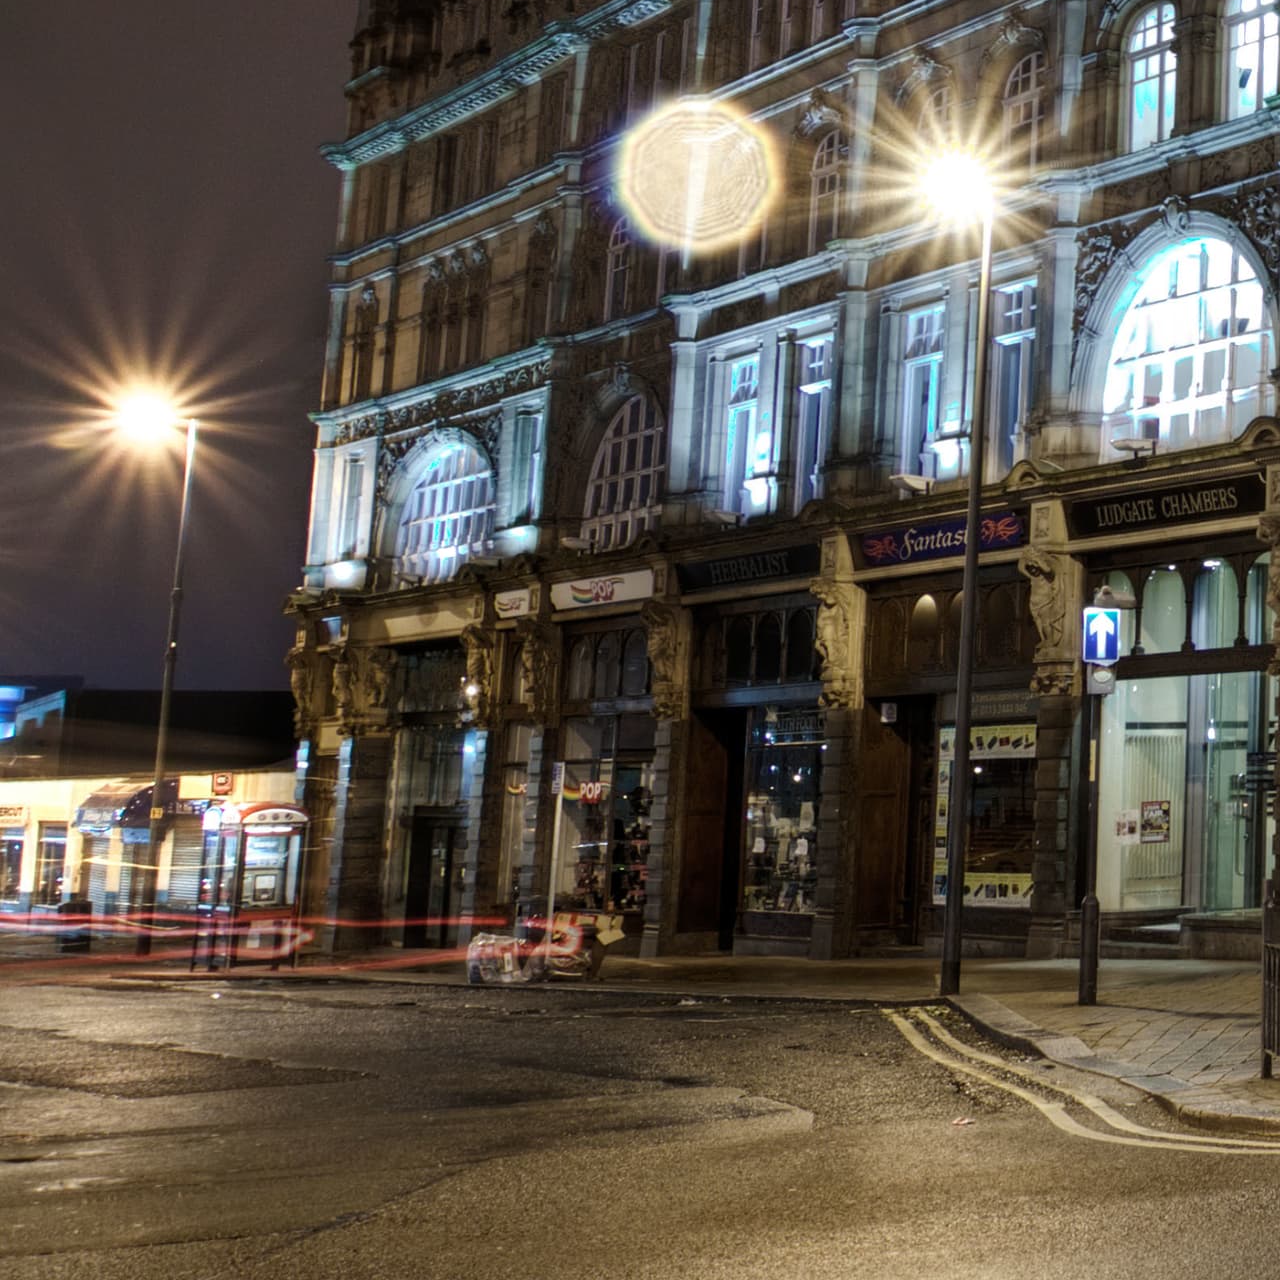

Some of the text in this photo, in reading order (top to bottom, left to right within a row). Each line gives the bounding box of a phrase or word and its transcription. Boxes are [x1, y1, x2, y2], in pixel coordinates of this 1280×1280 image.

[1097, 487, 1238, 527] LUDGATE CHAMBERS
[710, 552, 791, 585] HERBALIST
[590, 579, 613, 595] POP
[580, 782, 601, 799] POP
